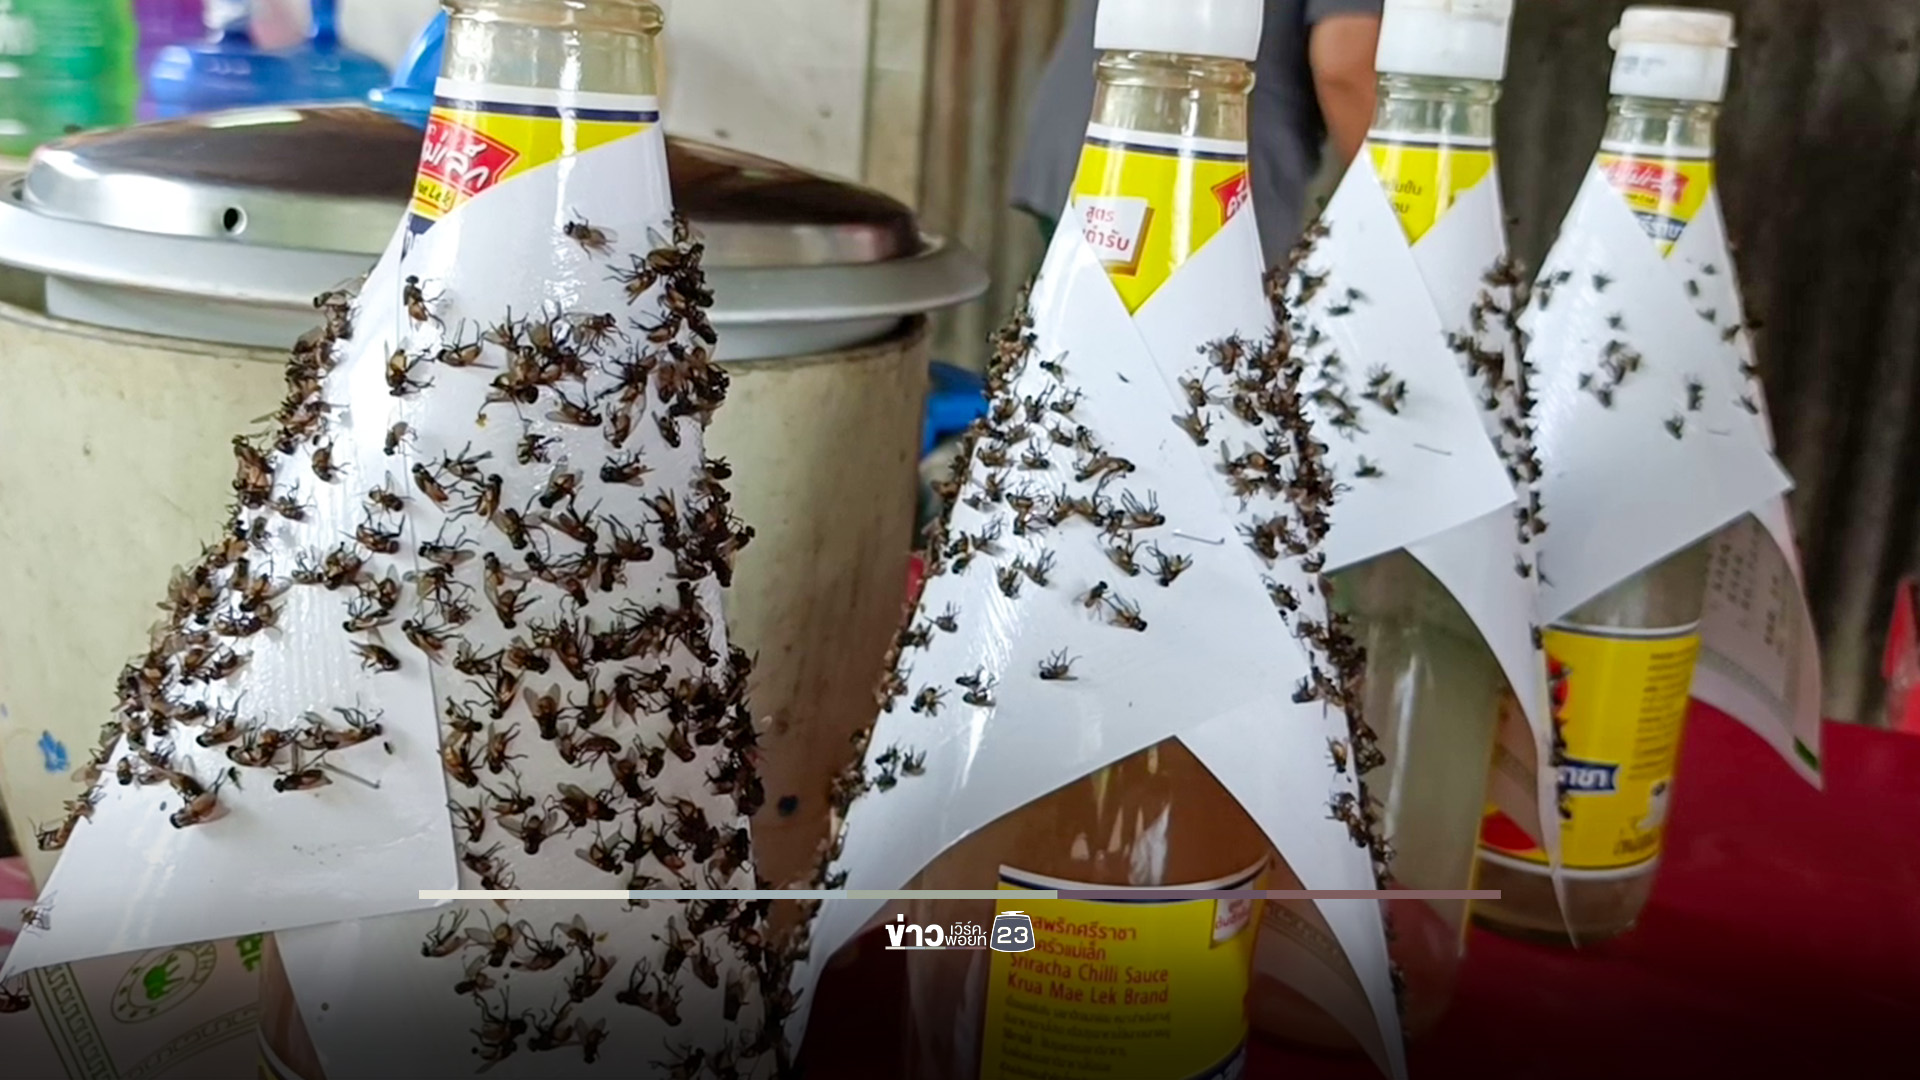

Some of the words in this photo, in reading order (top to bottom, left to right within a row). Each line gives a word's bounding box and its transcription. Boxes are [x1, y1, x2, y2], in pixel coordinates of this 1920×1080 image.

[1085, 205, 1115, 224] สูตร
[1082, 225, 1130, 252] ตำรับ
[1031, 915, 1137, 941] สพริกศรีราชา
[1010, 952, 1072, 980] Sriracha
[1078, 963, 1118, 984] Chilli
[1125, 966, 1169, 984] Sauce
[1007, 971, 1043, 996] Krua
[1050, 980, 1084, 1001] Mae
[1091, 985, 1117, 1005] Lek
[1124, 984, 1169, 1006] Brand
